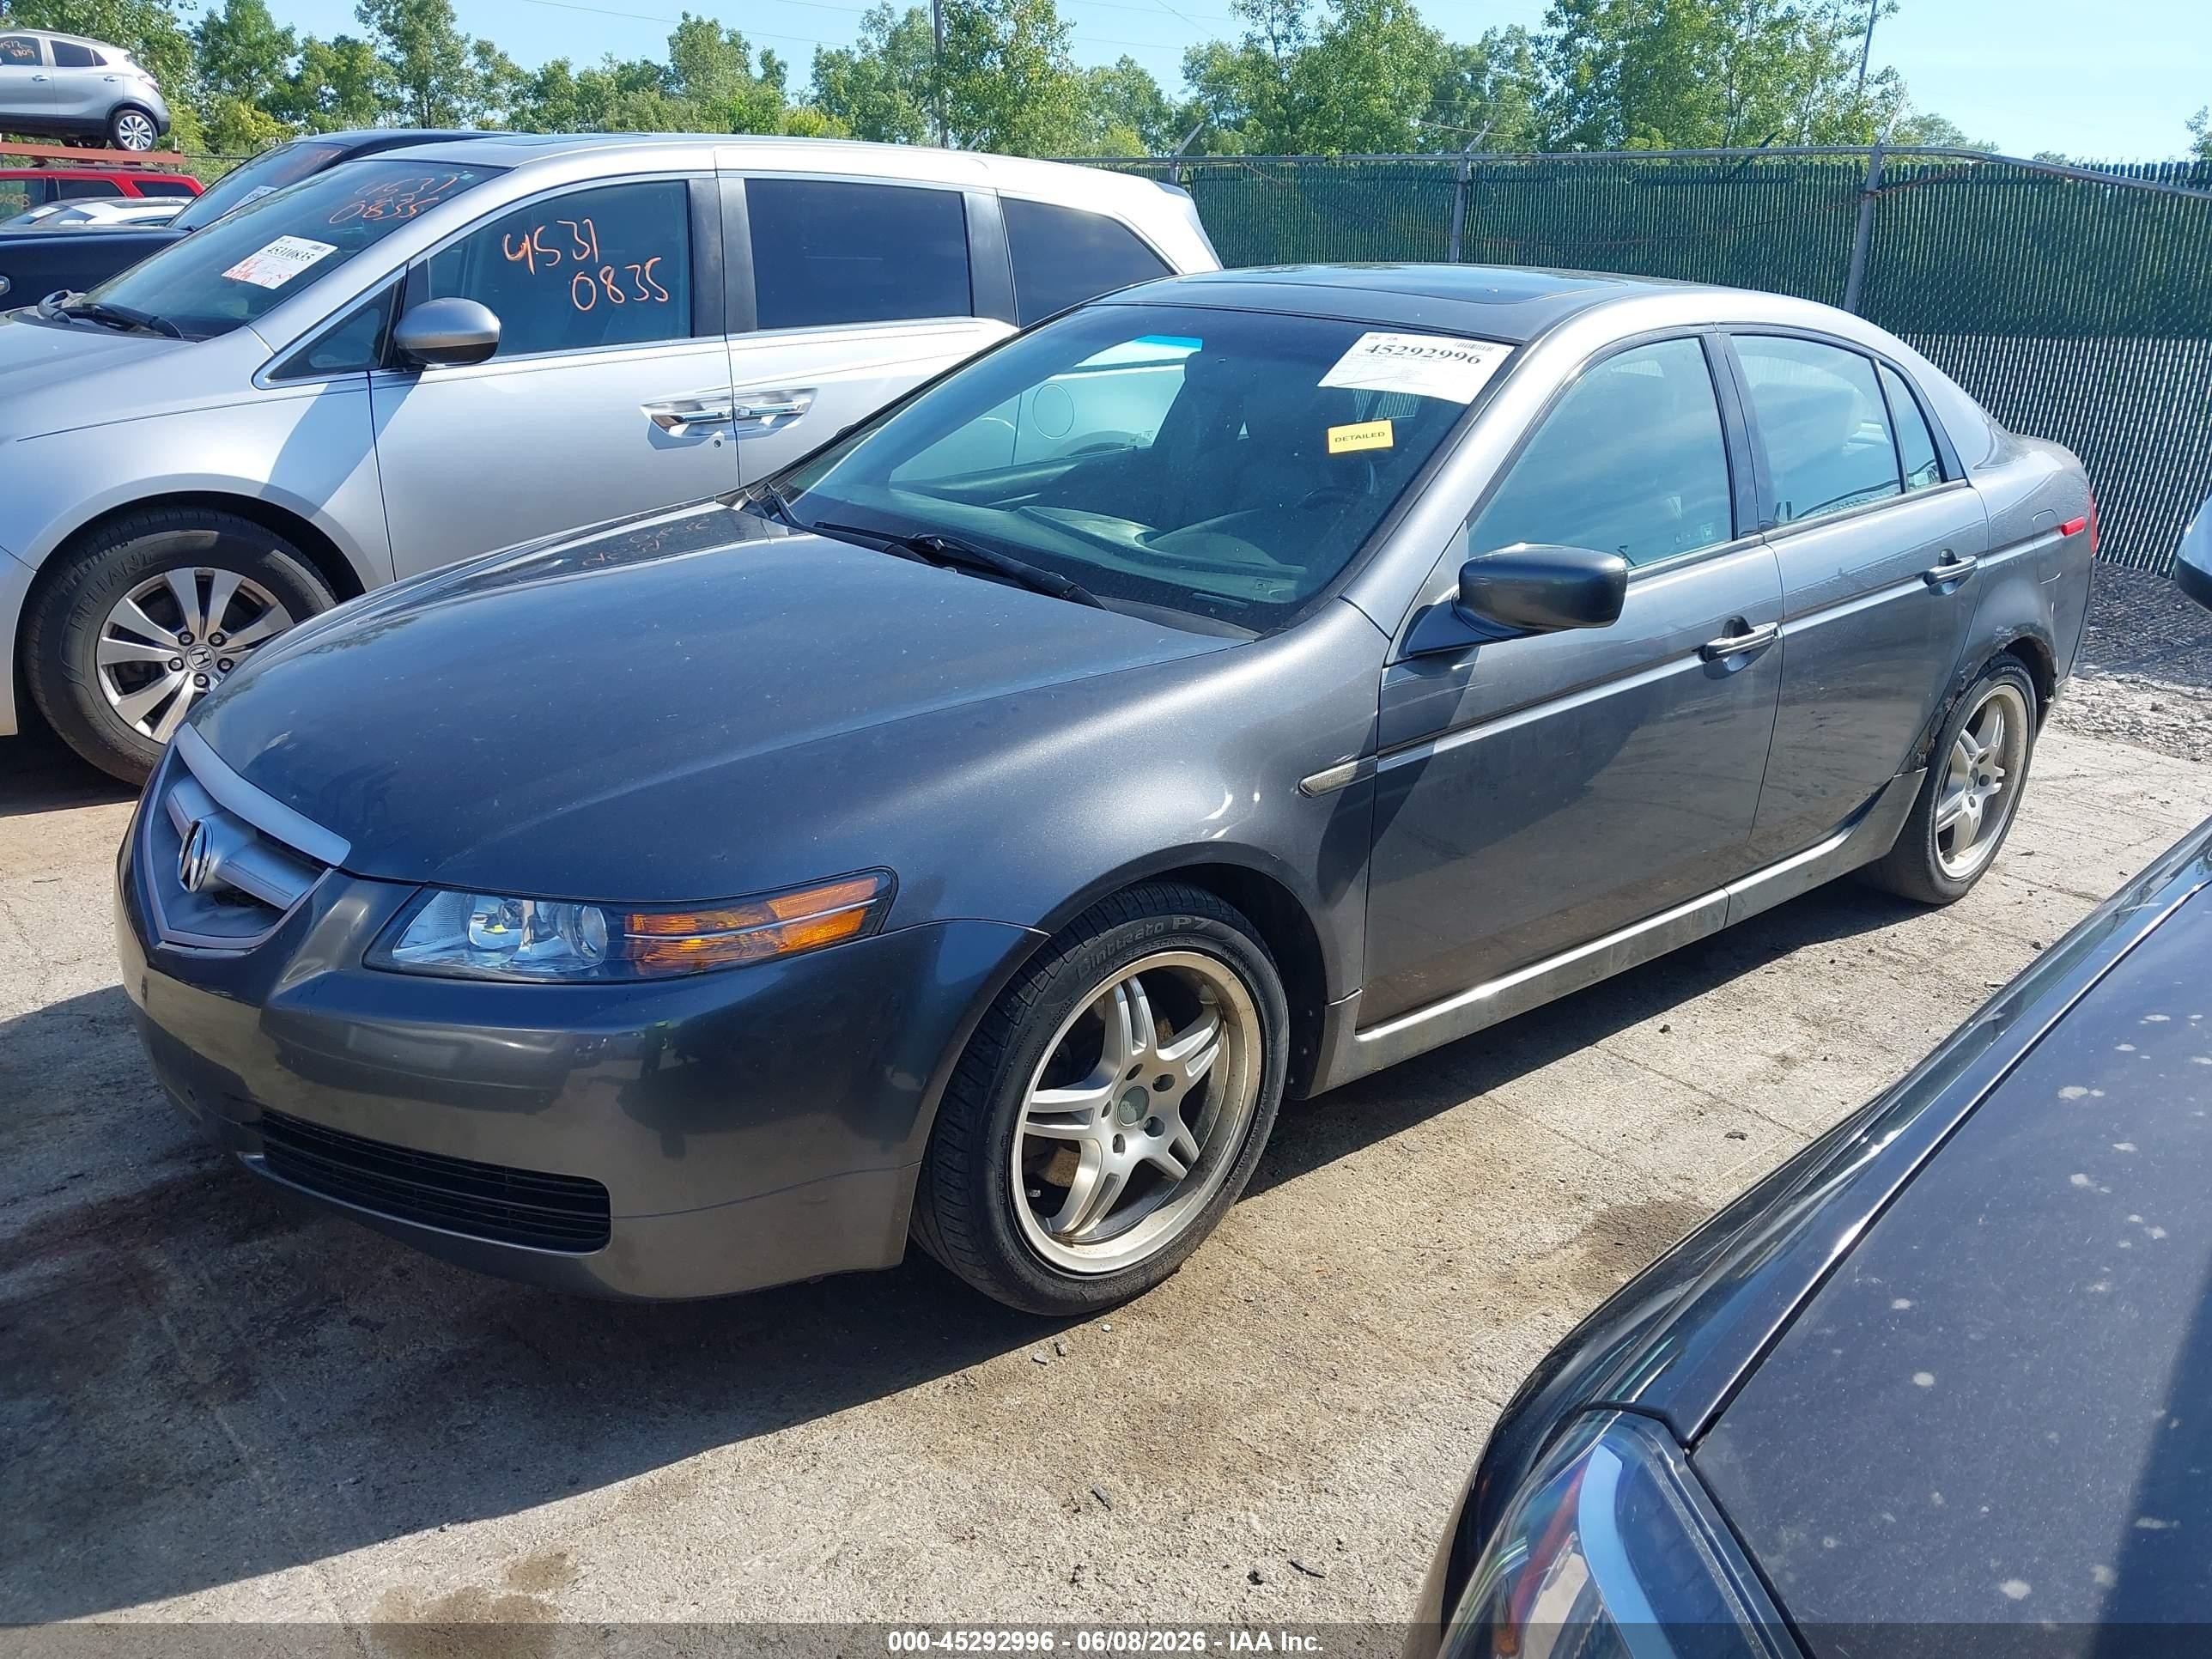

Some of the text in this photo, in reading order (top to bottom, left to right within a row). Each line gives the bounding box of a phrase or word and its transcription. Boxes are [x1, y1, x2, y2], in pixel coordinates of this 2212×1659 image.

[329, 197, 440, 224] 0835
[501, 218, 599, 275] 4531
[571, 257, 669, 311] 0835
[1364, 343, 1482, 365] 45292996
[1334, 431, 1386, 443] DETAILED
